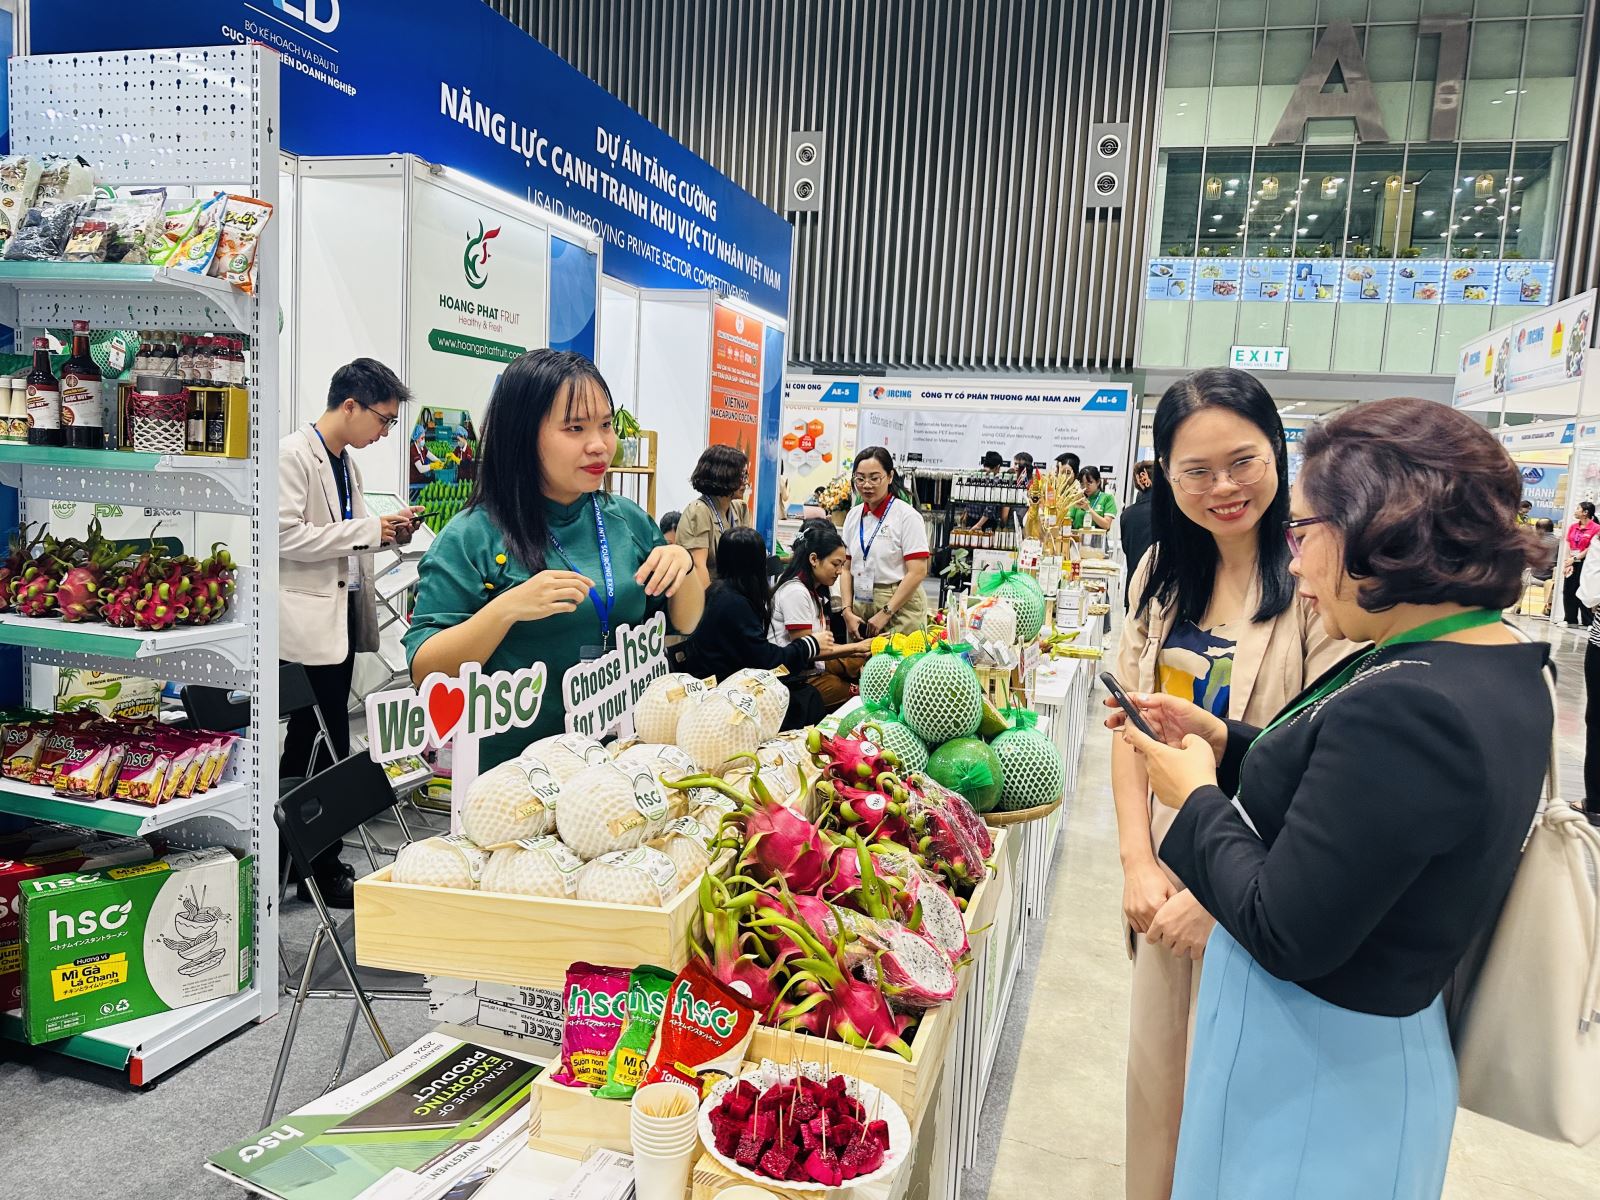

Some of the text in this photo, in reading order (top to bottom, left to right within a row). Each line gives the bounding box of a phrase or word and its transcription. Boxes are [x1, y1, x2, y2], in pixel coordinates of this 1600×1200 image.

[296, 60, 326, 84] DOANH
[328, 75, 357, 96] NGHIỆP
[596, 126, 717, 222] DỰ ÁN TĂNG CƯỜNG
[440, 81, 781, 292] NĂNG LỰC CẠNH TRANH KHU VỰC TƯ NHÂN VIỆT NAM
[527, 186, 750, 302] USAID IMPROVING PRIVATE SECTOR COMPETITIVENESS
[440, 294, 520, 326] HOANG PHAT FRUIT
[458, 315, 502, 333] Healthy & Fresh
[1235, 350, 1284, 362] EXIT
[724, 396, 749, 410] VIETNAM
[1096, 396, 1118, 404] AE-6
[1524, 487, 1554, 498] THANH
[94, 504, 124, 518] FDA
[601, 543, 612, 577] SOURCING
[606, 576, 614, 597] EXPO
[570, 657, 621, 707] Choose
[573, 661, 667, 738] for your health
[377, 671, 543, 754] We hsc
[634, 788, 662, 810] hsc
[48, 900, 132, 942] hsc
[62, 966, 100, 982] Mì Gà
[70, 971, 118, 988] Lá Chanh
[520, 991, 561, 1012] EXCEL
[672, 979, 738, 1038] hsc
[521, 1020, 562, 1040] EXCEL
[536, 1018, 562, 1028] PHOTOCOPY
[413, 1040, 435, 1055] 2024
[624, 1056, 637, 1067] Mì
[412, 1050, 488, 1103] PRODUCT
[413, 1055, 502, 1116] EXPORTING
[438, 1060, 514, 1117] CATALOGUE OF
